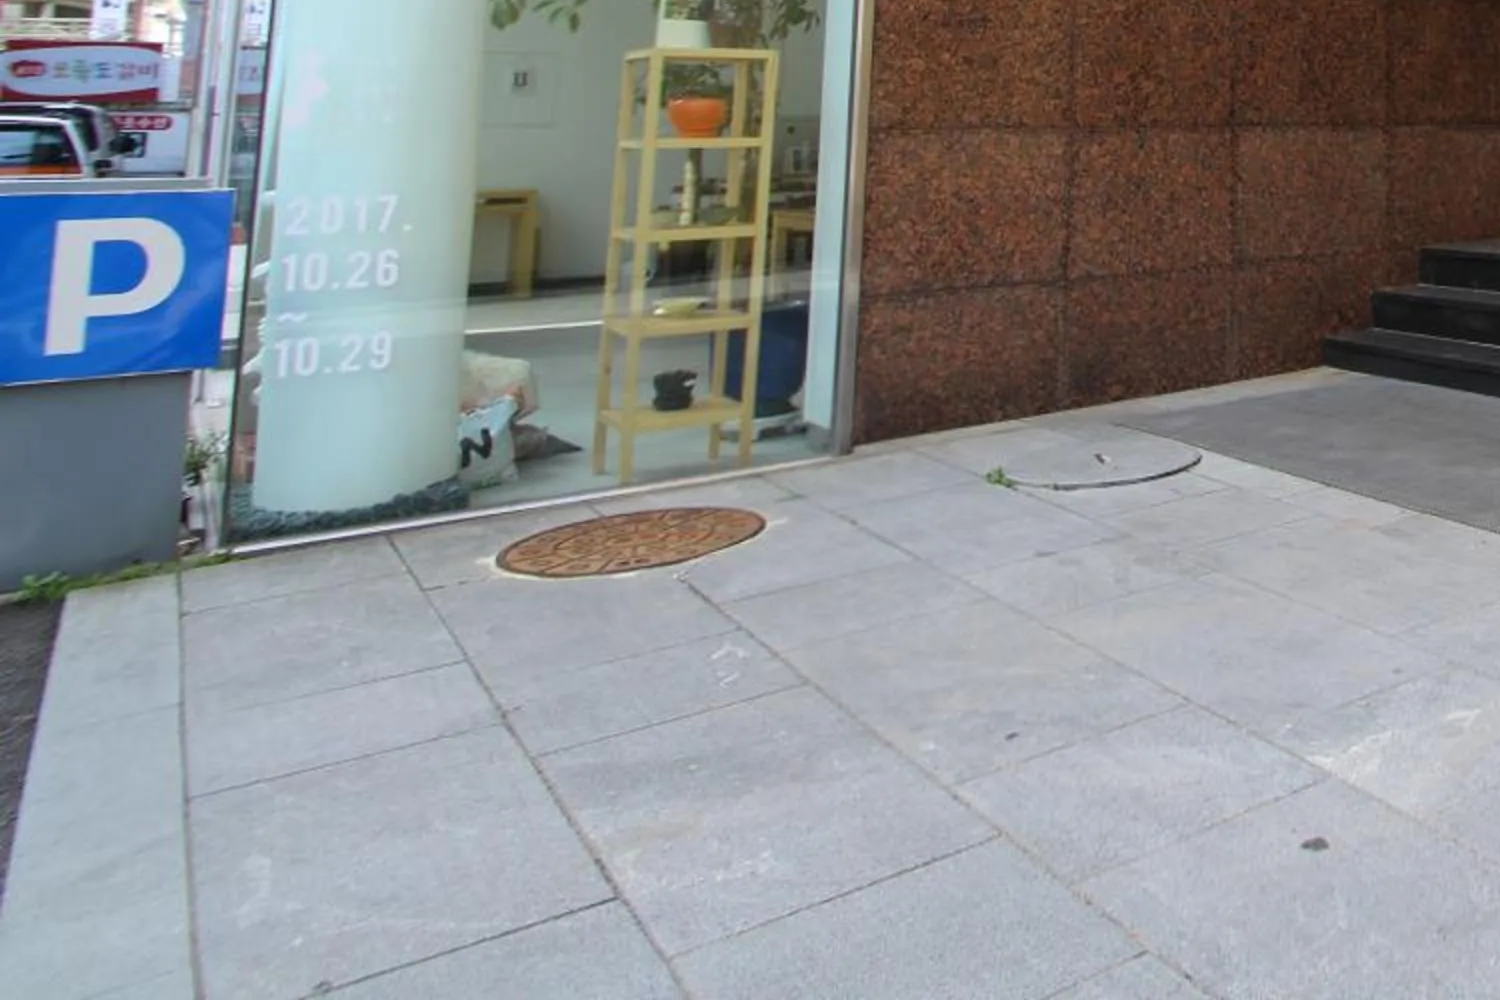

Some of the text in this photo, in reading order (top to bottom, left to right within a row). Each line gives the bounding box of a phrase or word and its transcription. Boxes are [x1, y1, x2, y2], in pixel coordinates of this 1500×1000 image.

[284, 194, 413, 237] 2017.
[43, 217, 186, 357] P
[280, 248, 400, 293] 10.26
[273, 331, 392, 379] 10.29
